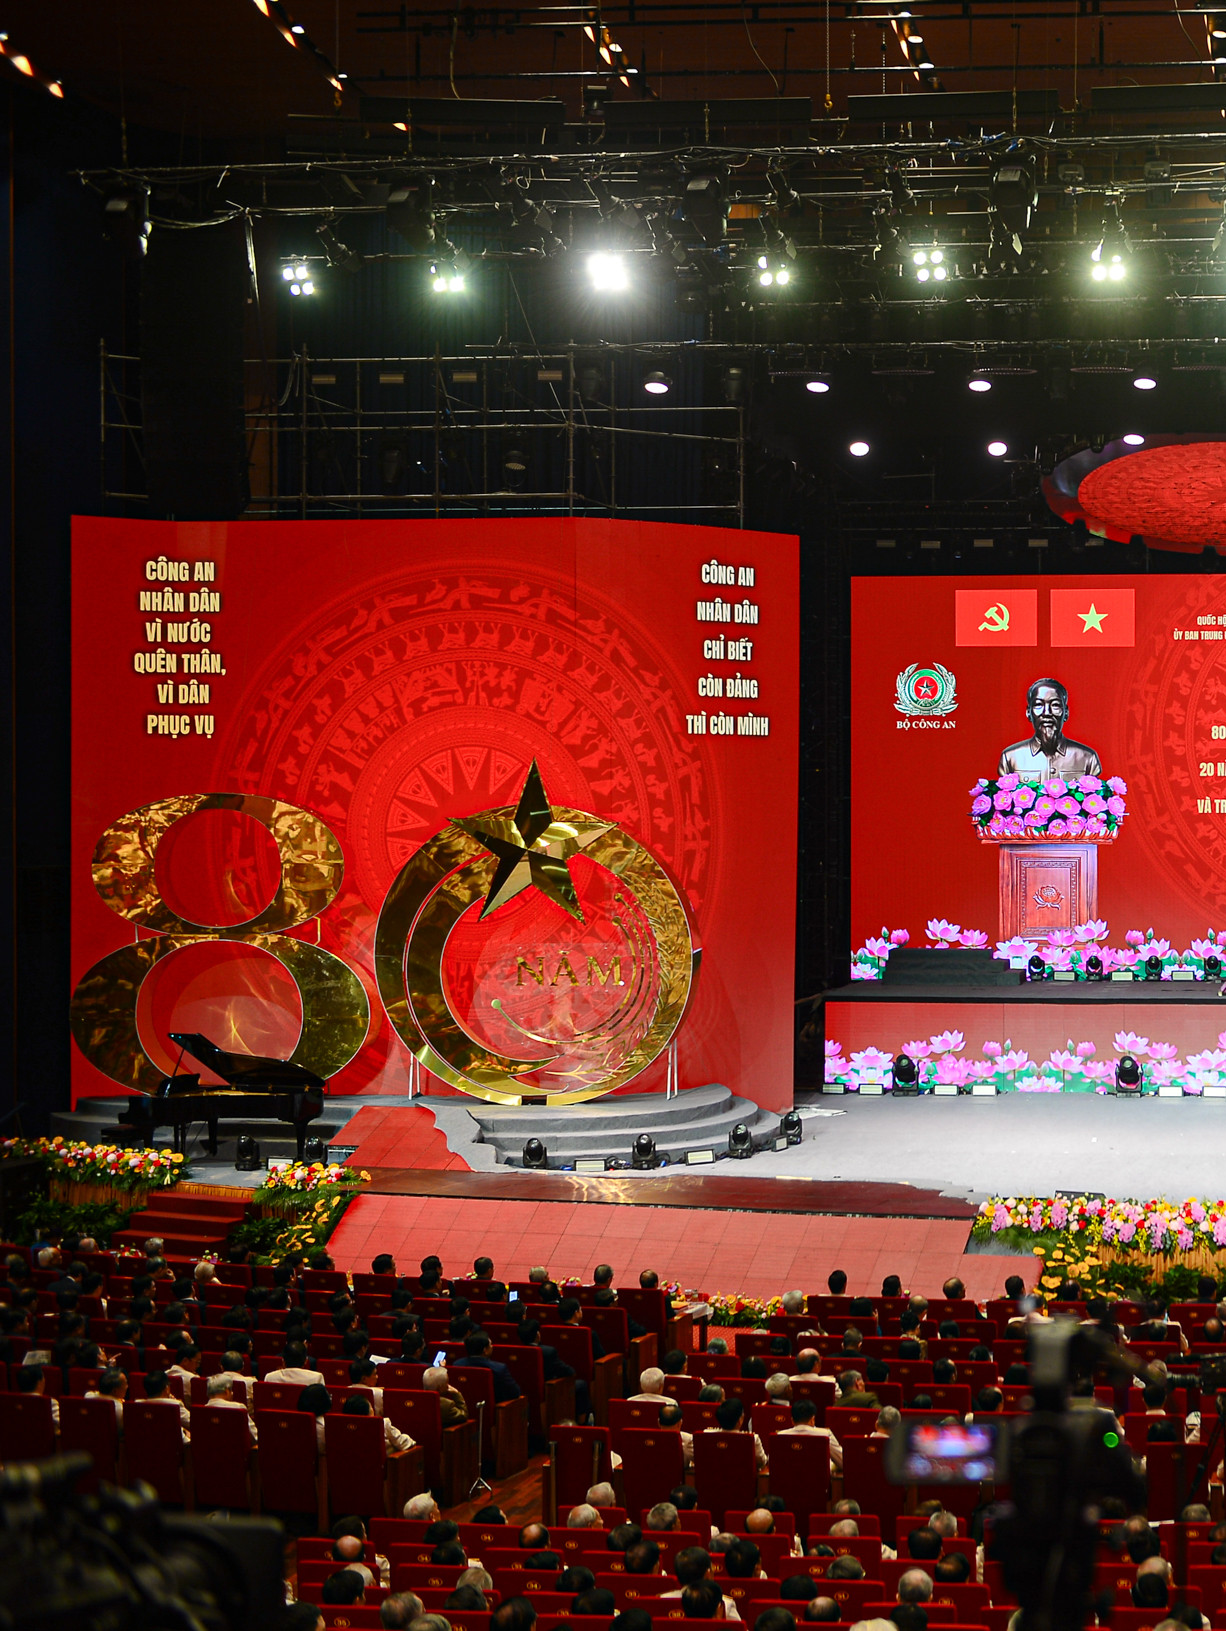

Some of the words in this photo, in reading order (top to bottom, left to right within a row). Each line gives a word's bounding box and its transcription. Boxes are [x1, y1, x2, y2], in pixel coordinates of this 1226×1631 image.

[146, 556, 189, 581] CÔNG
[194, 562, 214, 581] AN
[702, 559, 735, 585] CÔNG
[738, 567, 754, 586] AN
[140, 587, 184, 612] NHÂN
[190, 587, 220, 612] DÂN
[697, 598, 731, 622] NHÂN
[734, 600, 758, 624] DÂN
[146, 618, 162, 642] VÌ
[167, 618, 211, 642] NƯỚC
[1197, 614, 1216, 626] QUỐC
[1174, 628, 1184, 640] ỦY
[1184, 630, 1198, 640] BAN
[1200, 630, 1223, 640] TRUNG
[704, 634, 724, 659] CHỈ
[727, 637, 753, 660] BIẾT
[134, 648, 177, 673] QUÊN
[181, 649, 226, 676] THÂN,
[157, 680, 174, 703] VÌ
[179, 679, 209, 704] DÂN
[698, 673, 722, 697] CÒN
[726, 672, 758, 698] ĐẢNG
[147, 715, 190, 738] PHỤC
[194, 715, 214, 738] VỤ
[686, 710, 706, 734] THÌ
[710, 711, 734, 735] CÒN
[737, 712, 769, 736] MÌNH
[896, 719, 910, 730] BỘ
[912, 719, 940, 728] CÔNG
[1211, 725, 1226, 740] 80
[1199, 762, 1215, 777] 20
[1197, 796, 1212, 814] VÀ
[516, 950, 622, 986] NĂM
